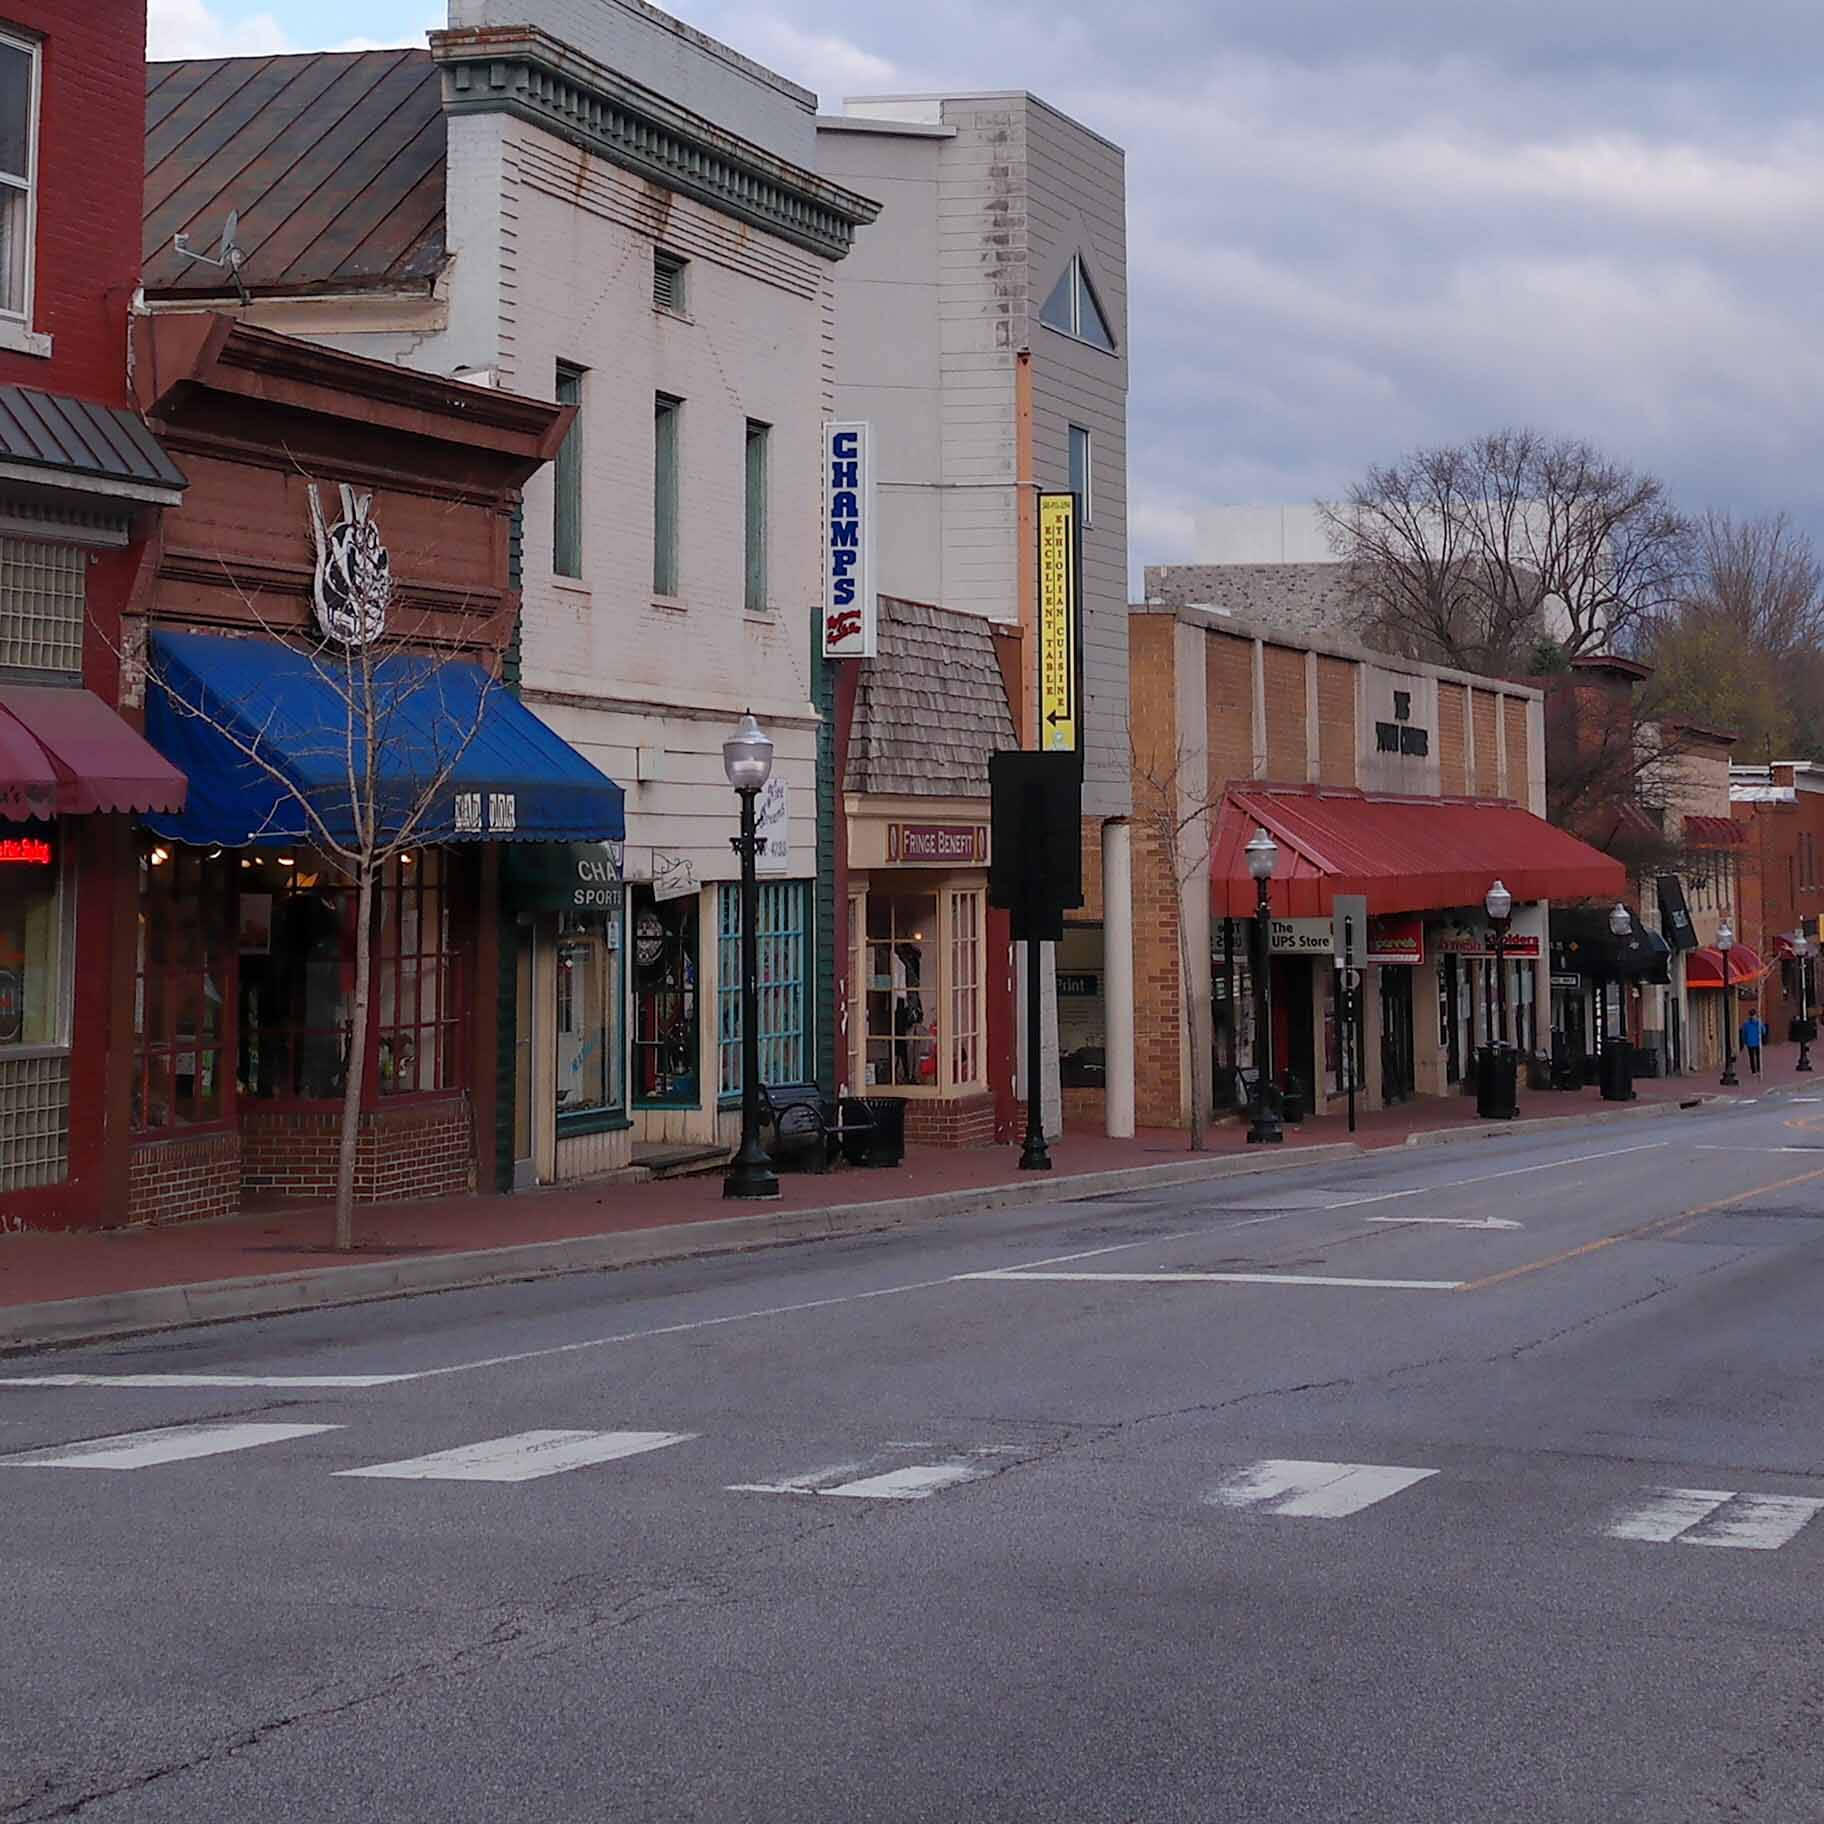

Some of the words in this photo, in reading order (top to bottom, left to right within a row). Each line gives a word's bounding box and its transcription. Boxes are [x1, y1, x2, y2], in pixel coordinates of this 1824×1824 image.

[830, 431, 859, 606] CHAMPS
[1044, 526, 1053, 629] EXCELLENT
[1055, 515, 1064, 617] ETHIOPIAN
[1045, 639, 1054, 696] TABLE
[1056, 626, 1065, 707] CUISINE
[903, 830, 936, 854] FRINGE
[937, 830, 973, 854] BENEFIT
[1271, 922, 1294, 934] The
[1271, 935, 1296, 948] UPS
[1299, 935, 1329, 947] Store
